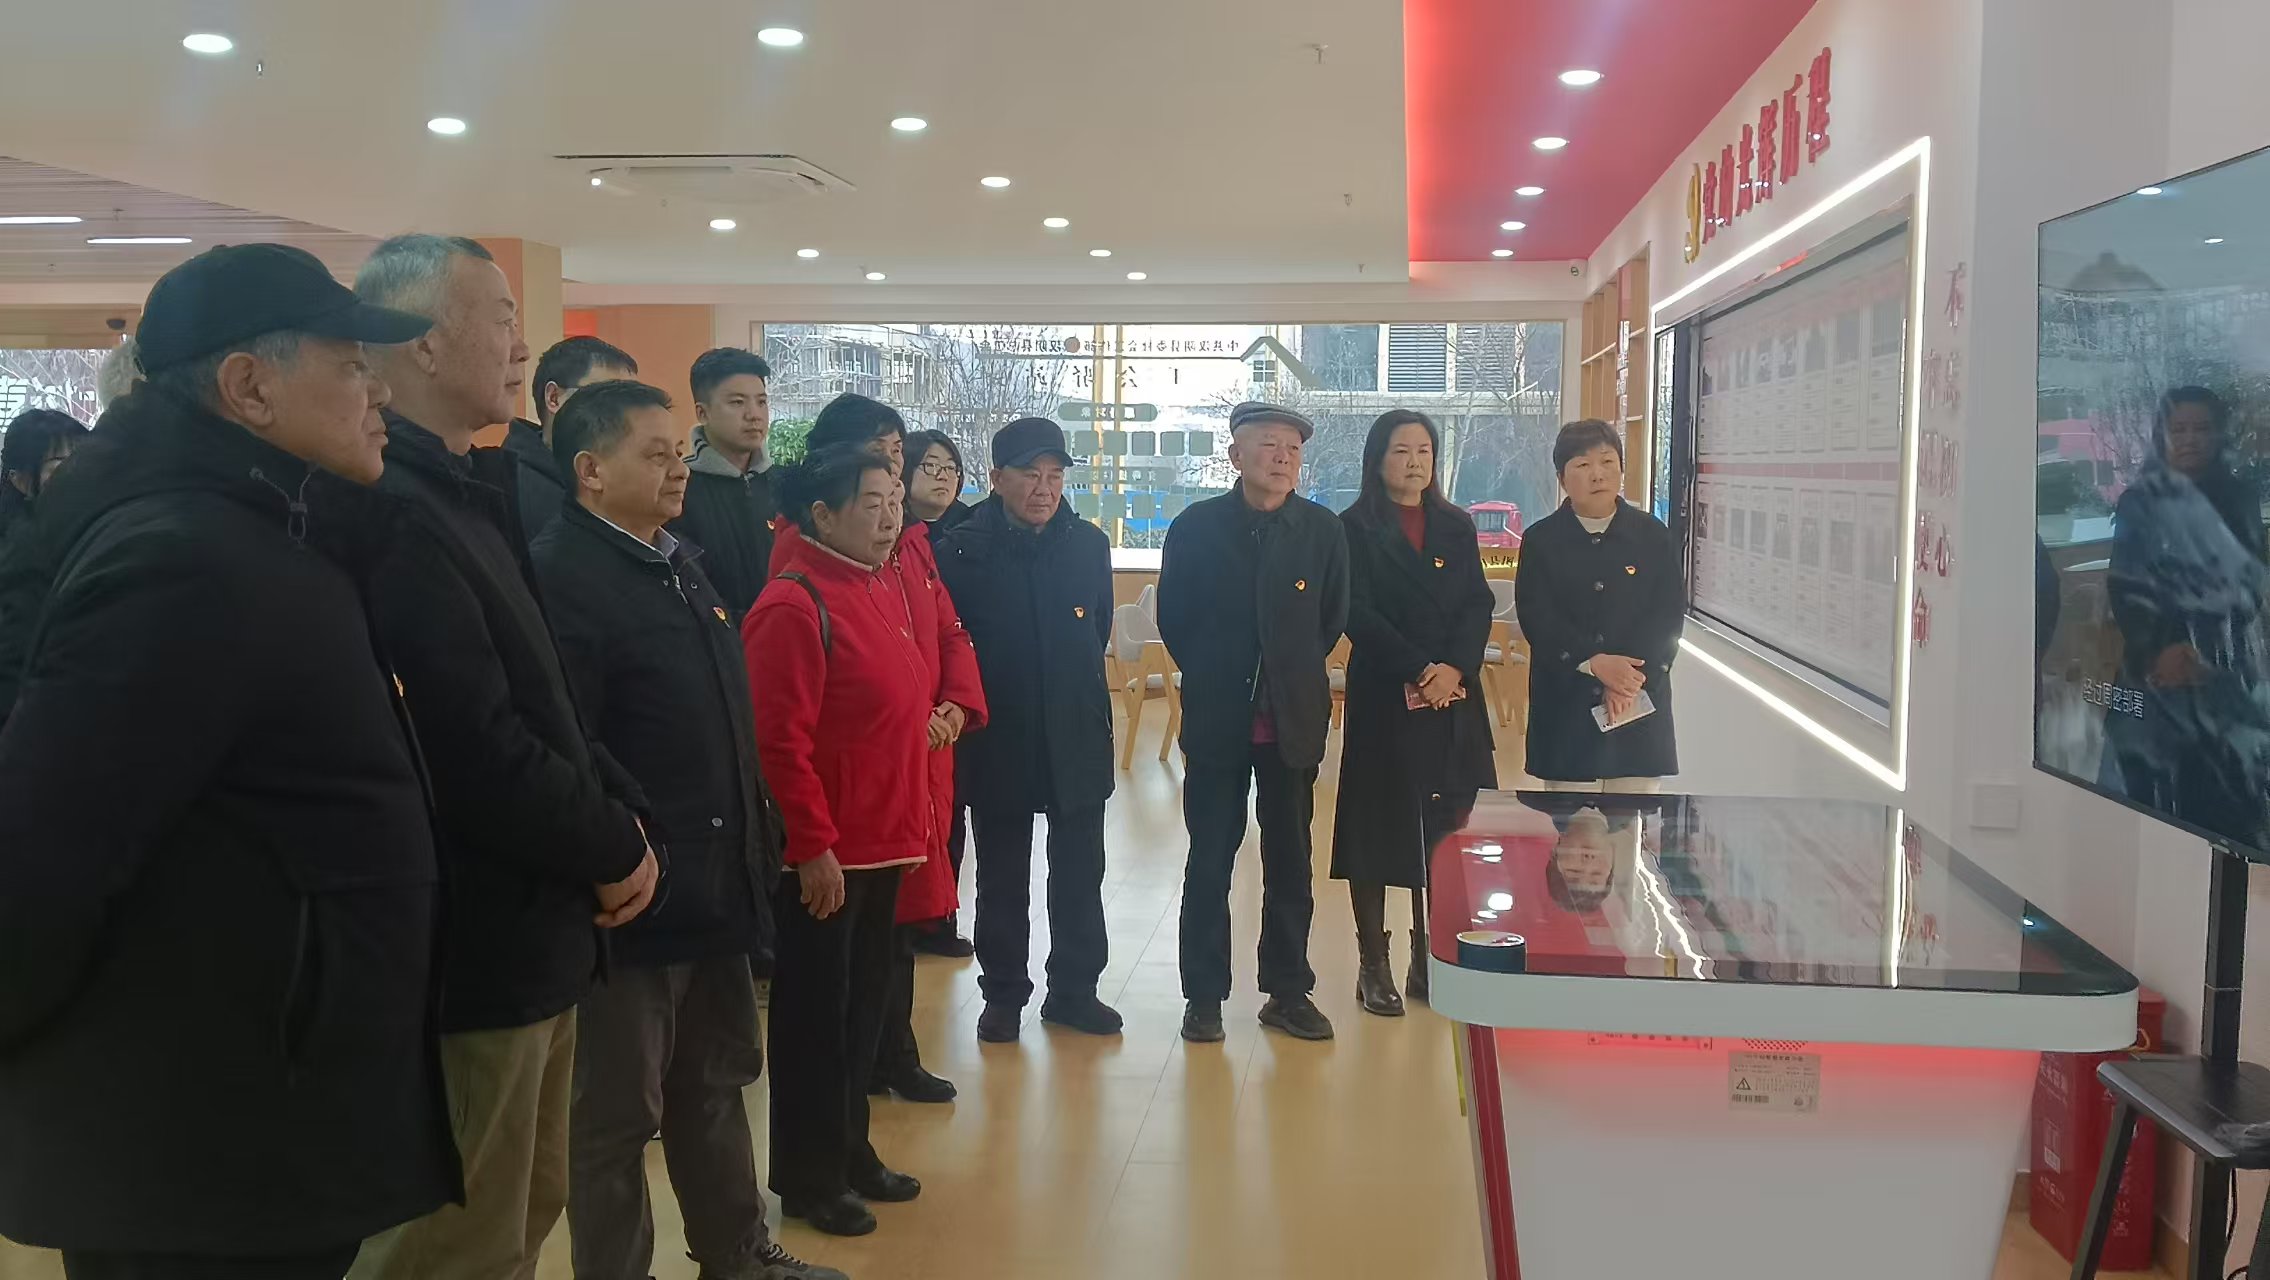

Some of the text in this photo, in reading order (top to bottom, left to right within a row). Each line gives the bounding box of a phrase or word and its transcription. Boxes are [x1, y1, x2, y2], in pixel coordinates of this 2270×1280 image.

[2082, 678, 2144, 718] 经过周密部署
